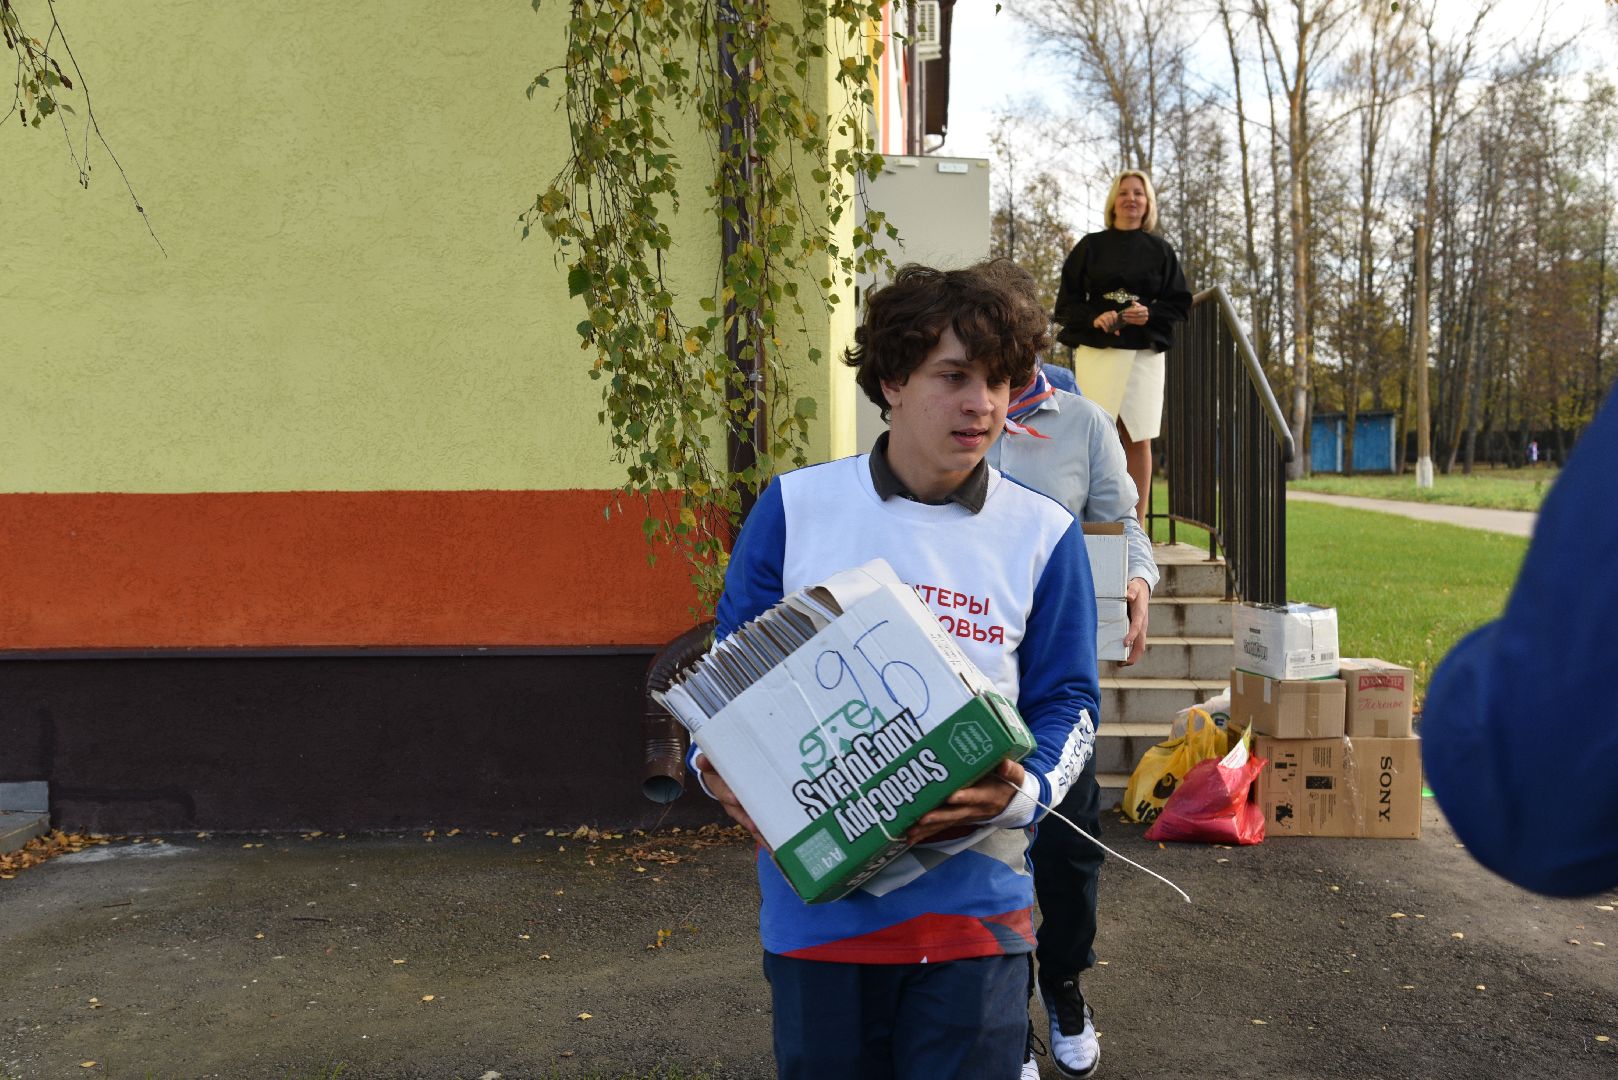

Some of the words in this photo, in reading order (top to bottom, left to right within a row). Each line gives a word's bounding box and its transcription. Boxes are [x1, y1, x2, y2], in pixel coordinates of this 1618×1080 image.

[915, 584, 990, 616] ТЕРЫ
[938, 615, 1004, 645] ОВЬЯ
[833, 747, 951, 843] SvetoCopy
[1379, 756, 1393, 821] SONY
